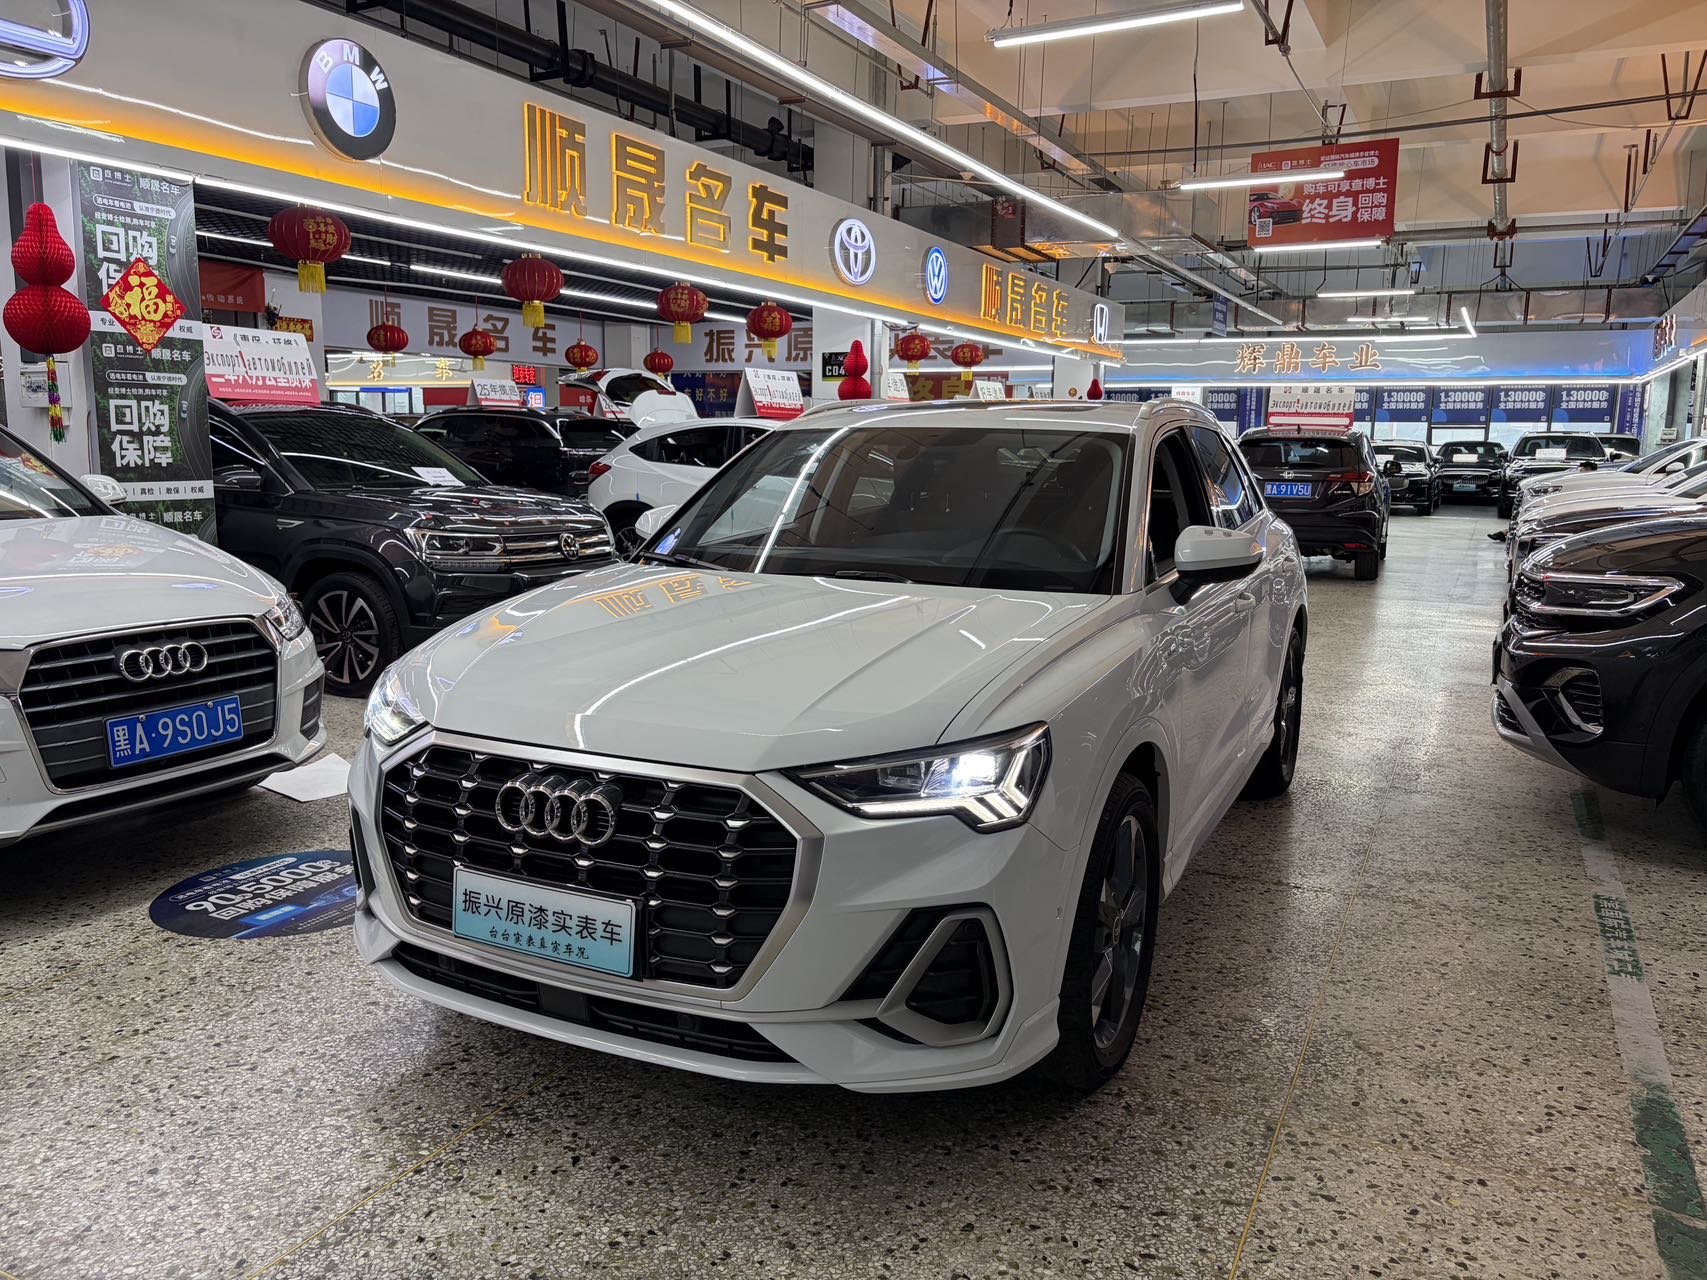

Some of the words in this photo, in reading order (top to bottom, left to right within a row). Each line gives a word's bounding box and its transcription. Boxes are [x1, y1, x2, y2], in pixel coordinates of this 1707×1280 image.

[316, 42, 389, 92] BMW
[139, 177, 181, 196] 顺晟名车
[521, 103, 789, 263] 顺晟名车
[1303, 177, 1388, 195] 购车可享查博士
[1301, 195, 1356, 225] 终身
[1357, 207, 1387, 223] 保障
[1358, 193, 1387, 208] 回购
[95, 224, 158, 265] 回购
[124, 274, 166, 321] 福
[981, 263, 1068, 338] 顺晟名车
[100, 316, 116, 328] 专业
[178, 325, 193, 335] 权威
[369, 299, 557, 356] 顺晟名车
[150, 348, 192, 362] 顺晟名车
[205, 350, 240, 372] Экспорт
[246, 355, 314, 377] автомобилей
[825, 365, 848, 376] C04
[1234, 342, 1383, 375] 辉鼎车业
[109, 399, 170, 433] 回购
[1270, 400, 1296, 411] Экспорт
[1300, 400, 1353, 412] автомобилей
[110, 434, 174, 468] 保障
[190, 486, 205, 494] 权威
[462, 888, 623, 946] 振兴原漆实表车
[488, 925, 590, 960] 台台实表真实车况
